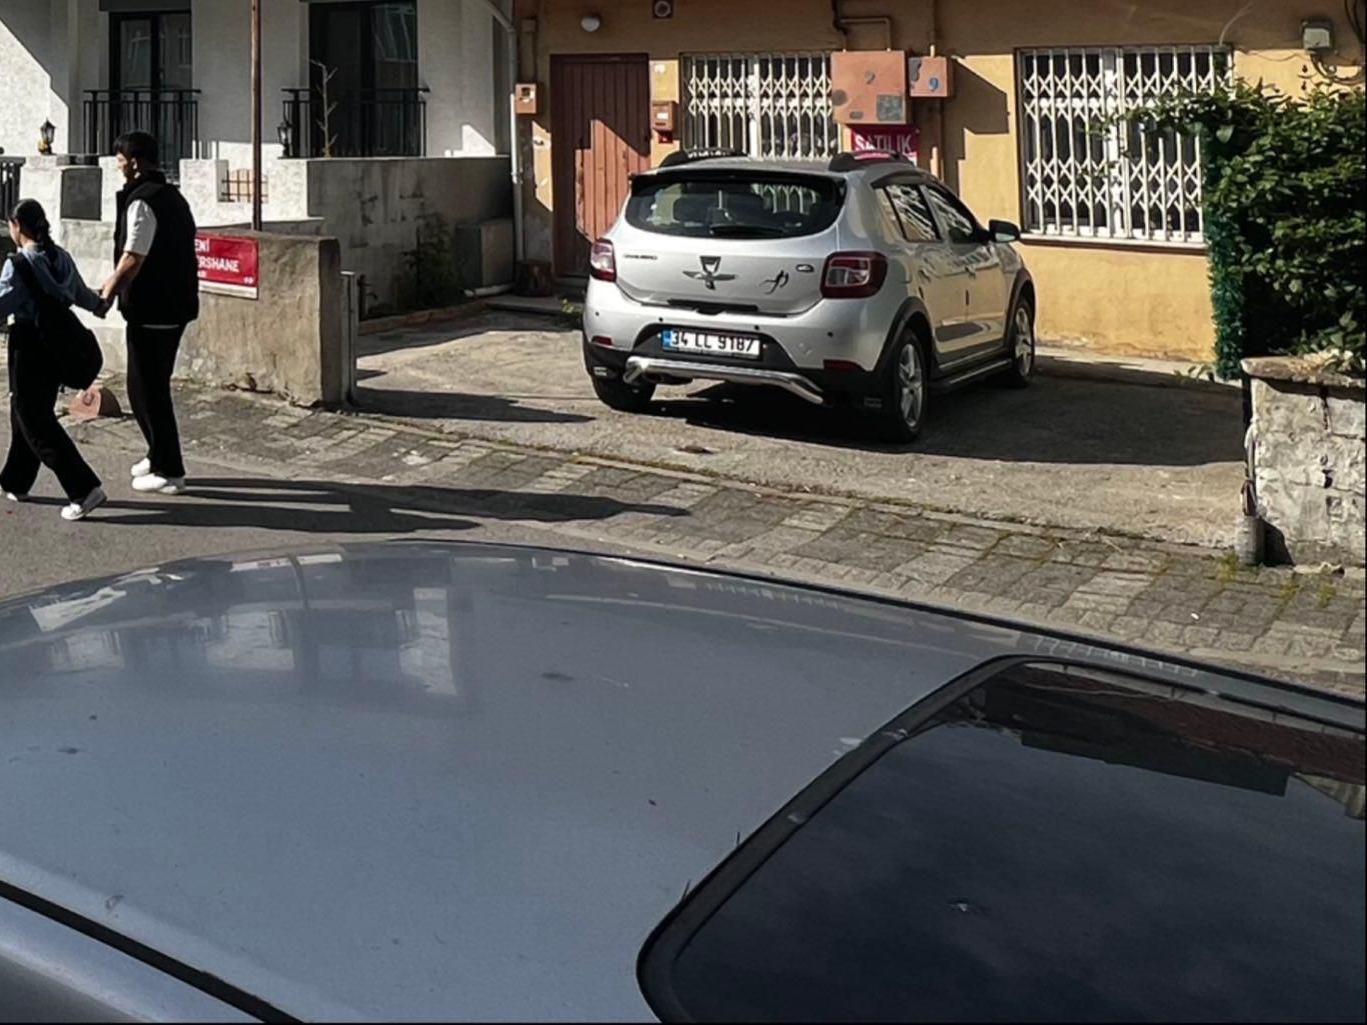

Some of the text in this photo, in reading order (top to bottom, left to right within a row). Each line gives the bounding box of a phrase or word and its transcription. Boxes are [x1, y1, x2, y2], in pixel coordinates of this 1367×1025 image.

[854, 133, 913, 155] SATILIK
[197, 255, 240, 273] RSHANE
[672, 330, 688, 346] 34
[695, 333, 712, 349] LL
[718, 335, 755, 352] 9187
